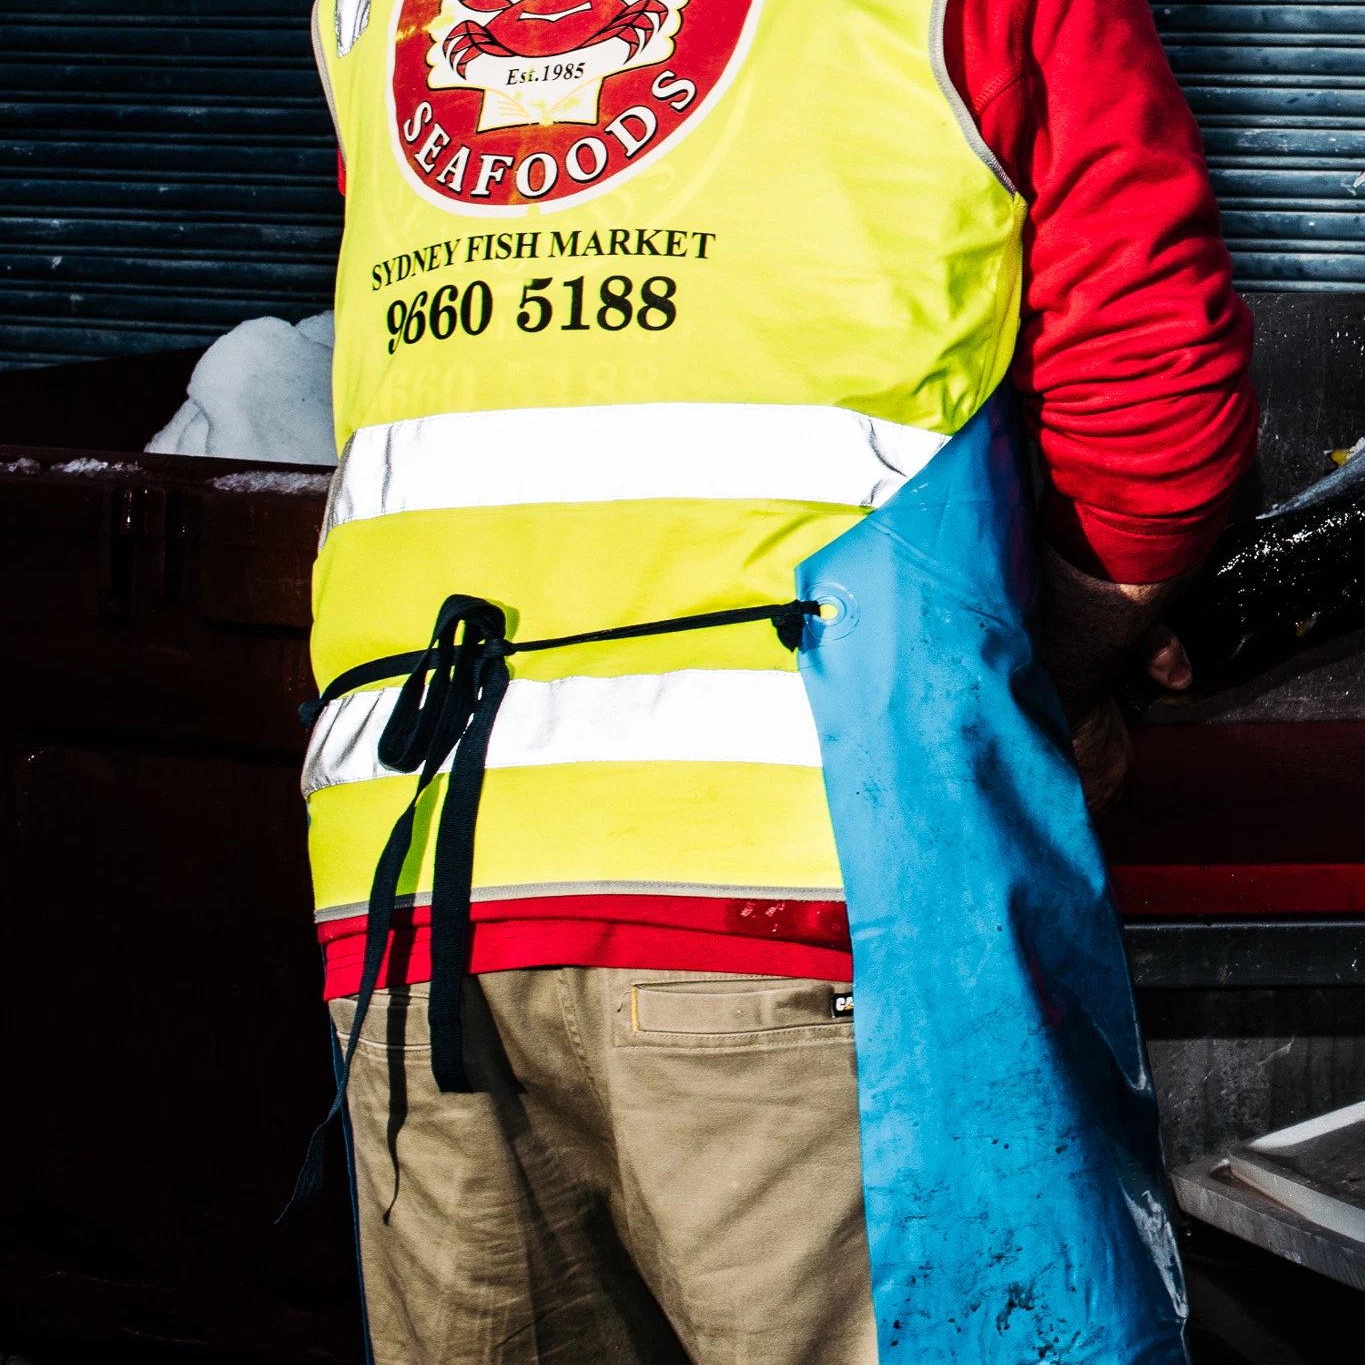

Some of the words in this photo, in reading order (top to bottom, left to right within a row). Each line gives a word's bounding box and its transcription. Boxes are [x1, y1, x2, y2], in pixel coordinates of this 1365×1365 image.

[403, 70, 698, 199] SEAFOODS
[371, 238, 461, 291] SYDNEY
[464, 231, 542, 264] FISH
[548, 227, 717, 260] MARKET
[386, 280, 494, 356] 9660
[515, 275, 678, 334] 5188
